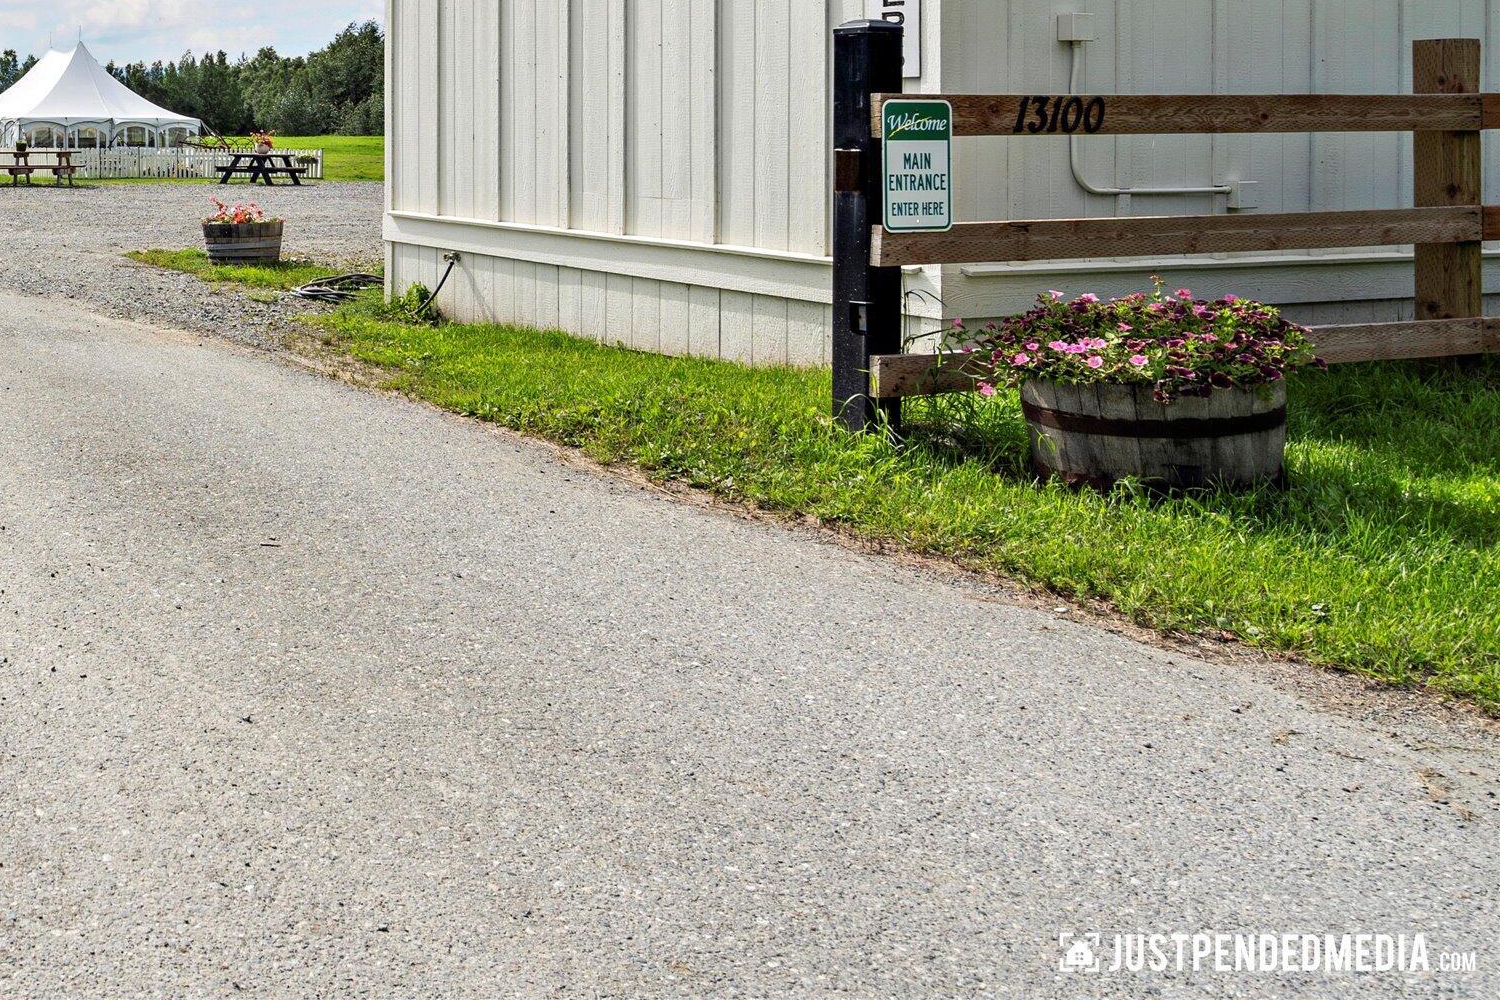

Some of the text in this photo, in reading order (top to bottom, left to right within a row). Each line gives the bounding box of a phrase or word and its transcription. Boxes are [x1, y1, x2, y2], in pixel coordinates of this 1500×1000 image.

[886, 112, 947, 132] Welcome
[1012, 95, 1106, 134] 13100
[903, 152, 932, 170] MAIN
[888, 173, 947, 192] ENTRANCE
[891, 201, 945, 217] ENTER HERE
